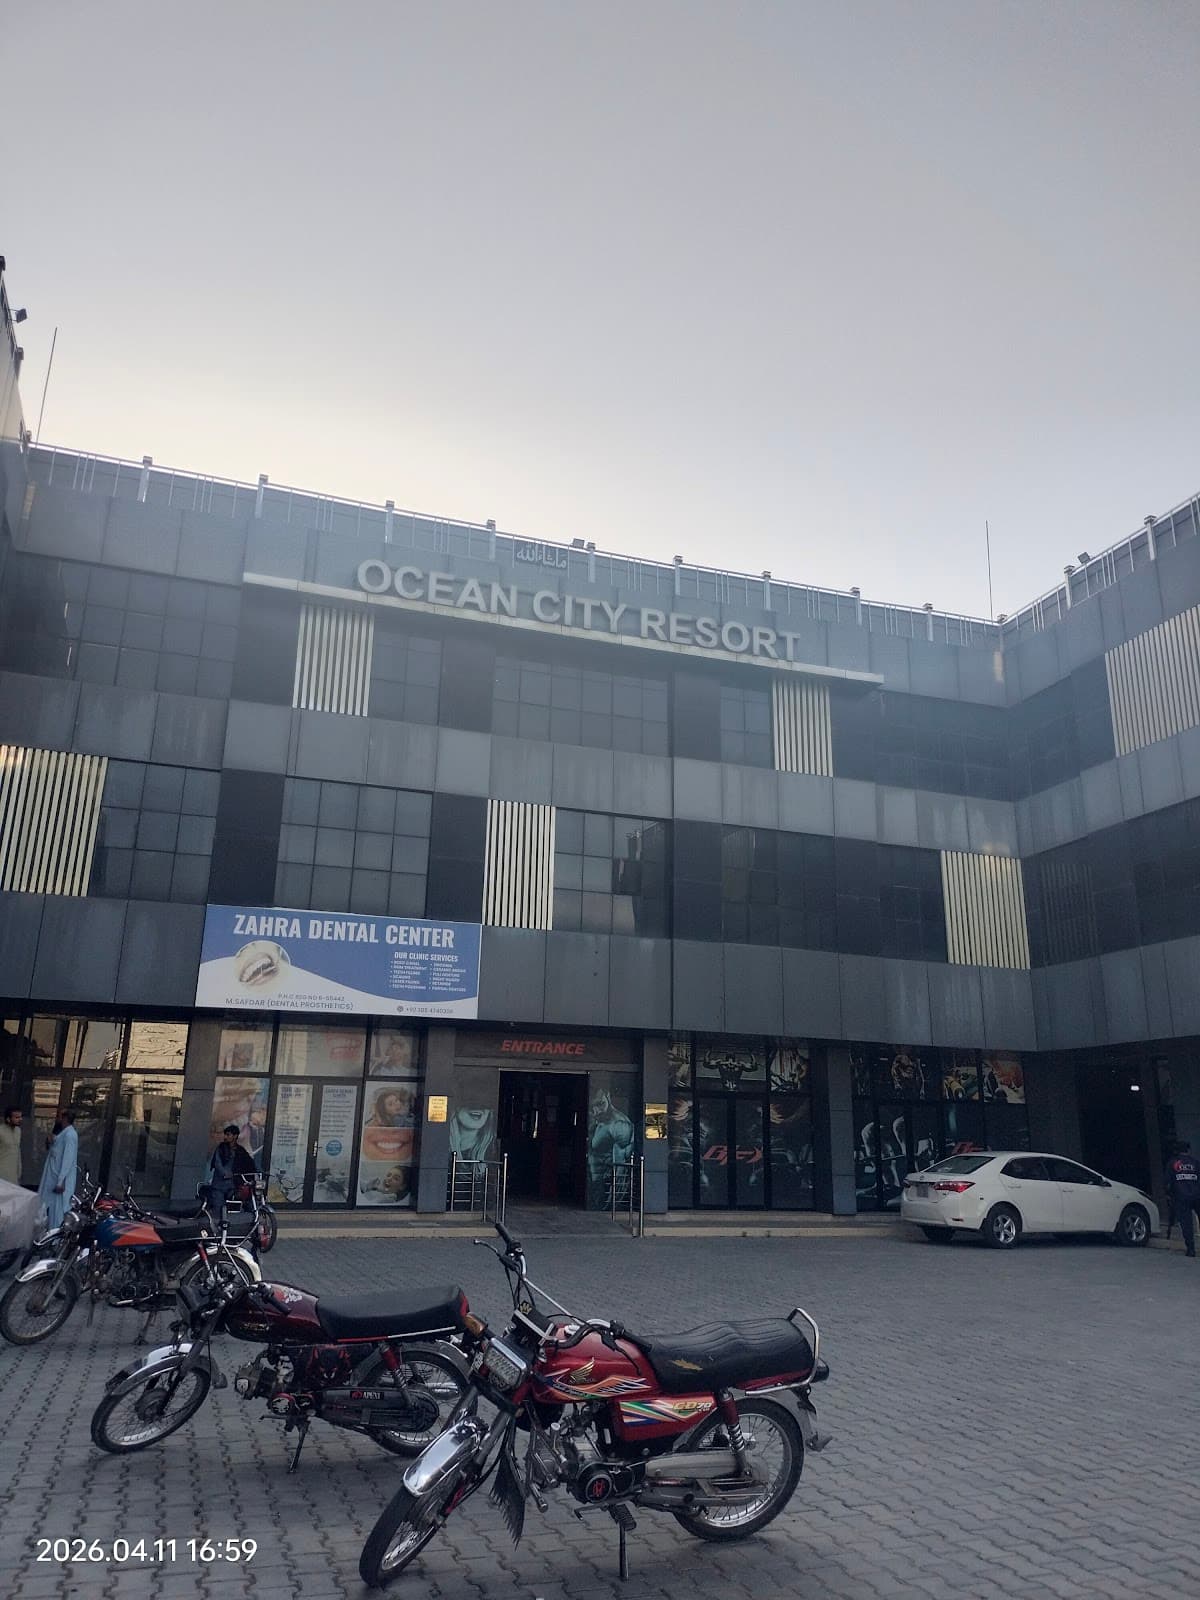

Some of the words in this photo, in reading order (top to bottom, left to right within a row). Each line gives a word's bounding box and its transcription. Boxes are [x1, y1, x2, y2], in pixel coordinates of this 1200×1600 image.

[356, 559, 518, 617] OCEAN
[532, 590, 628, 633] CITY
[640, 606, 801, 661] RESORT
[234, 914, 301, 938] ZAHRA
[308, 920, 379, 944] DENTAL
[386, 924, 455, 949] CENTER
[430, 954, 458, 962] SERVICES
[268, 999, 298, 1008] (DENTAL
[301, 1002, 354, 1010] PROSTHETICS)
[502, 1040, 585, 1056] ENTRANCE
